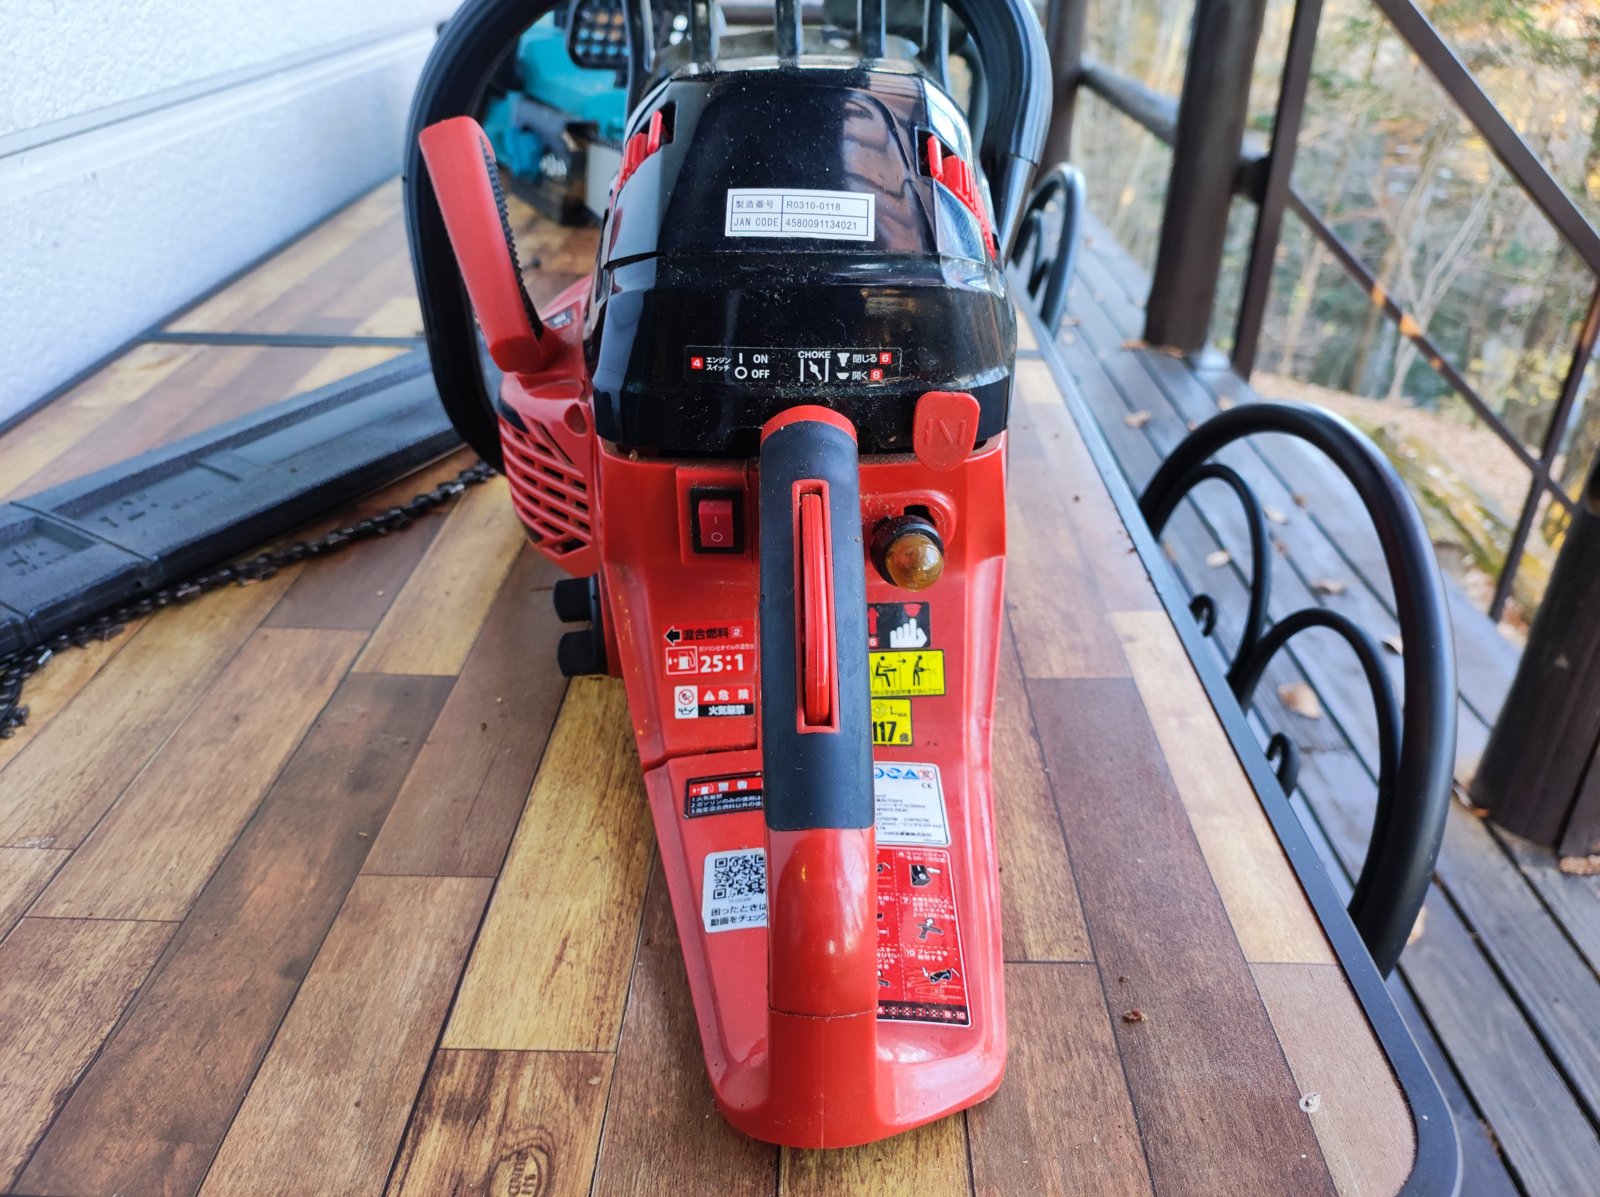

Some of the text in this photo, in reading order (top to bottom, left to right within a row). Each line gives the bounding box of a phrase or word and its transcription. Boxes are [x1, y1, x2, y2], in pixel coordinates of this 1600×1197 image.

[735, 200, 841, 211] 製造番号 R0310-0118
[733, 217, 857, 230] JAN CODE 4580091134021
[753, 354, 768, 364] ON
[797, 350, 832, 359] CHOKE
[852, 353, 878, 363] 閉じる
[693, 358, 701, 367] 4
[751, 369, 770, 379] OFF
[851, 371, 868, 380] 開く
[683, 628, 728, 640] 混合燃料
[700, 653, 744, 673] 25:1
